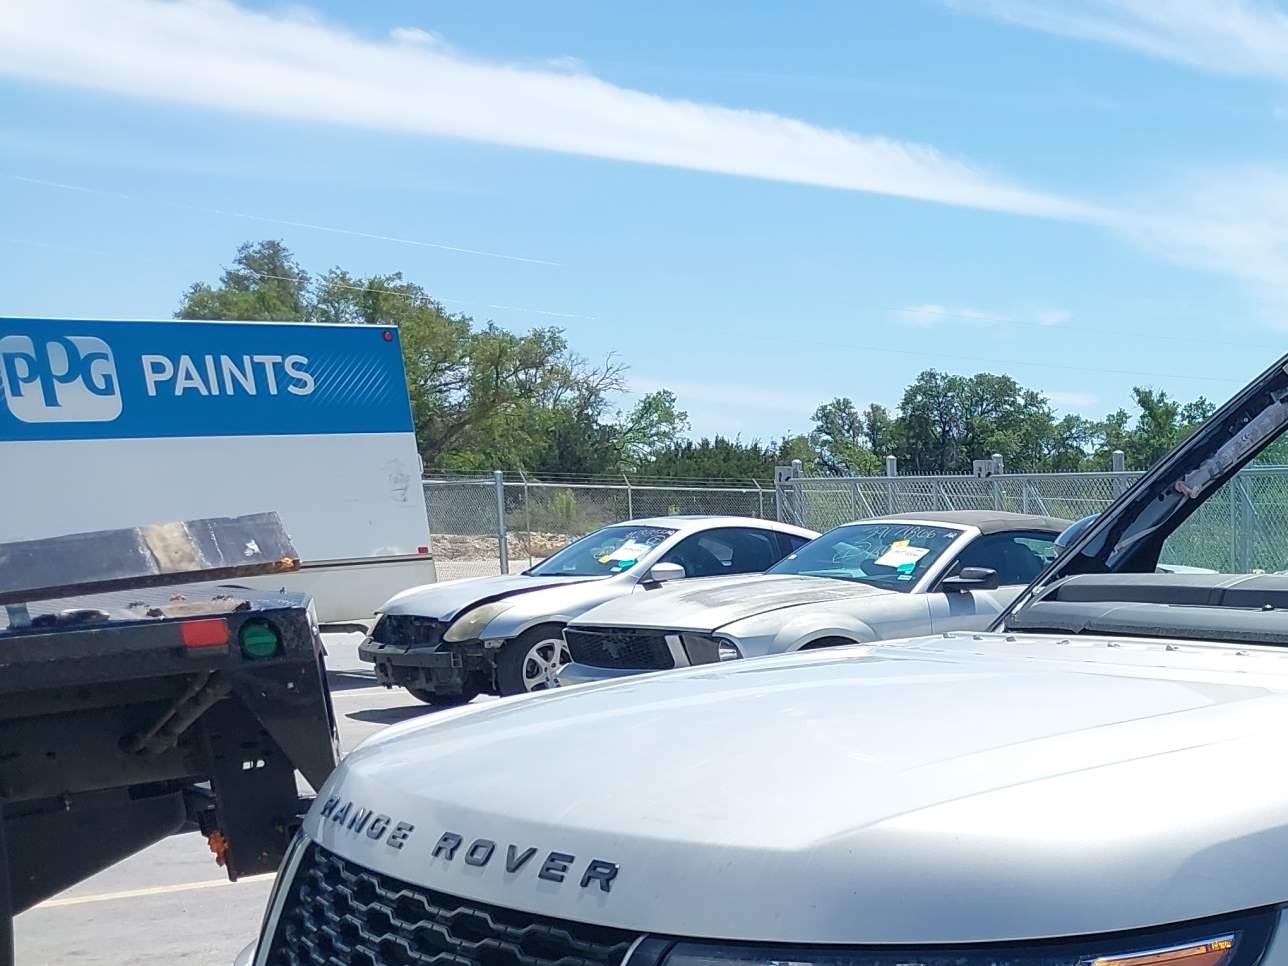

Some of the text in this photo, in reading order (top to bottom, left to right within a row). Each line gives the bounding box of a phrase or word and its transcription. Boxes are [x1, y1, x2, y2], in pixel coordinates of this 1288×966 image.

[2, 335, 316, 407] PPG PAINTS
[320, 796, 620, 893] RANGE ROVER
